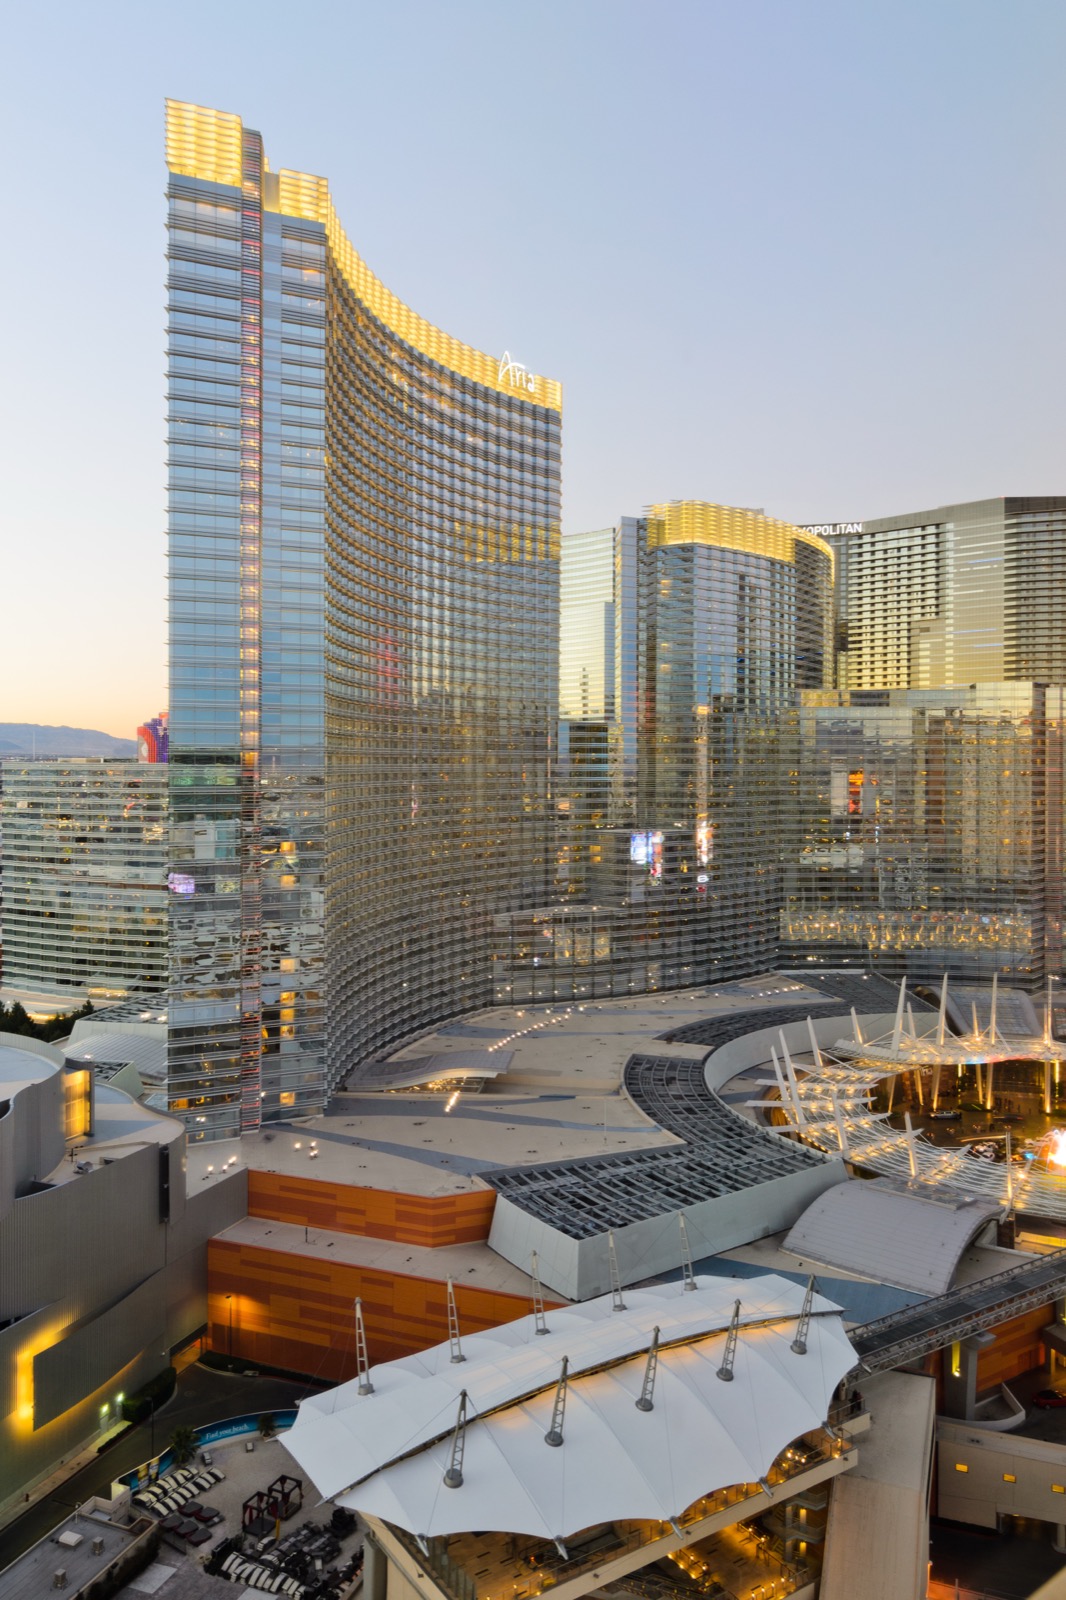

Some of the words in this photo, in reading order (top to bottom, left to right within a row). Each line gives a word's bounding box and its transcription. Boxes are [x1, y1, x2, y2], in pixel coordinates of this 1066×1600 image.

[498, 350, 535, 392] Aria
[797, 523, 862, 536] OPOLITAN
[206, 1431, 219, 1440] Find
[219, 1428, 232, 1437] your
